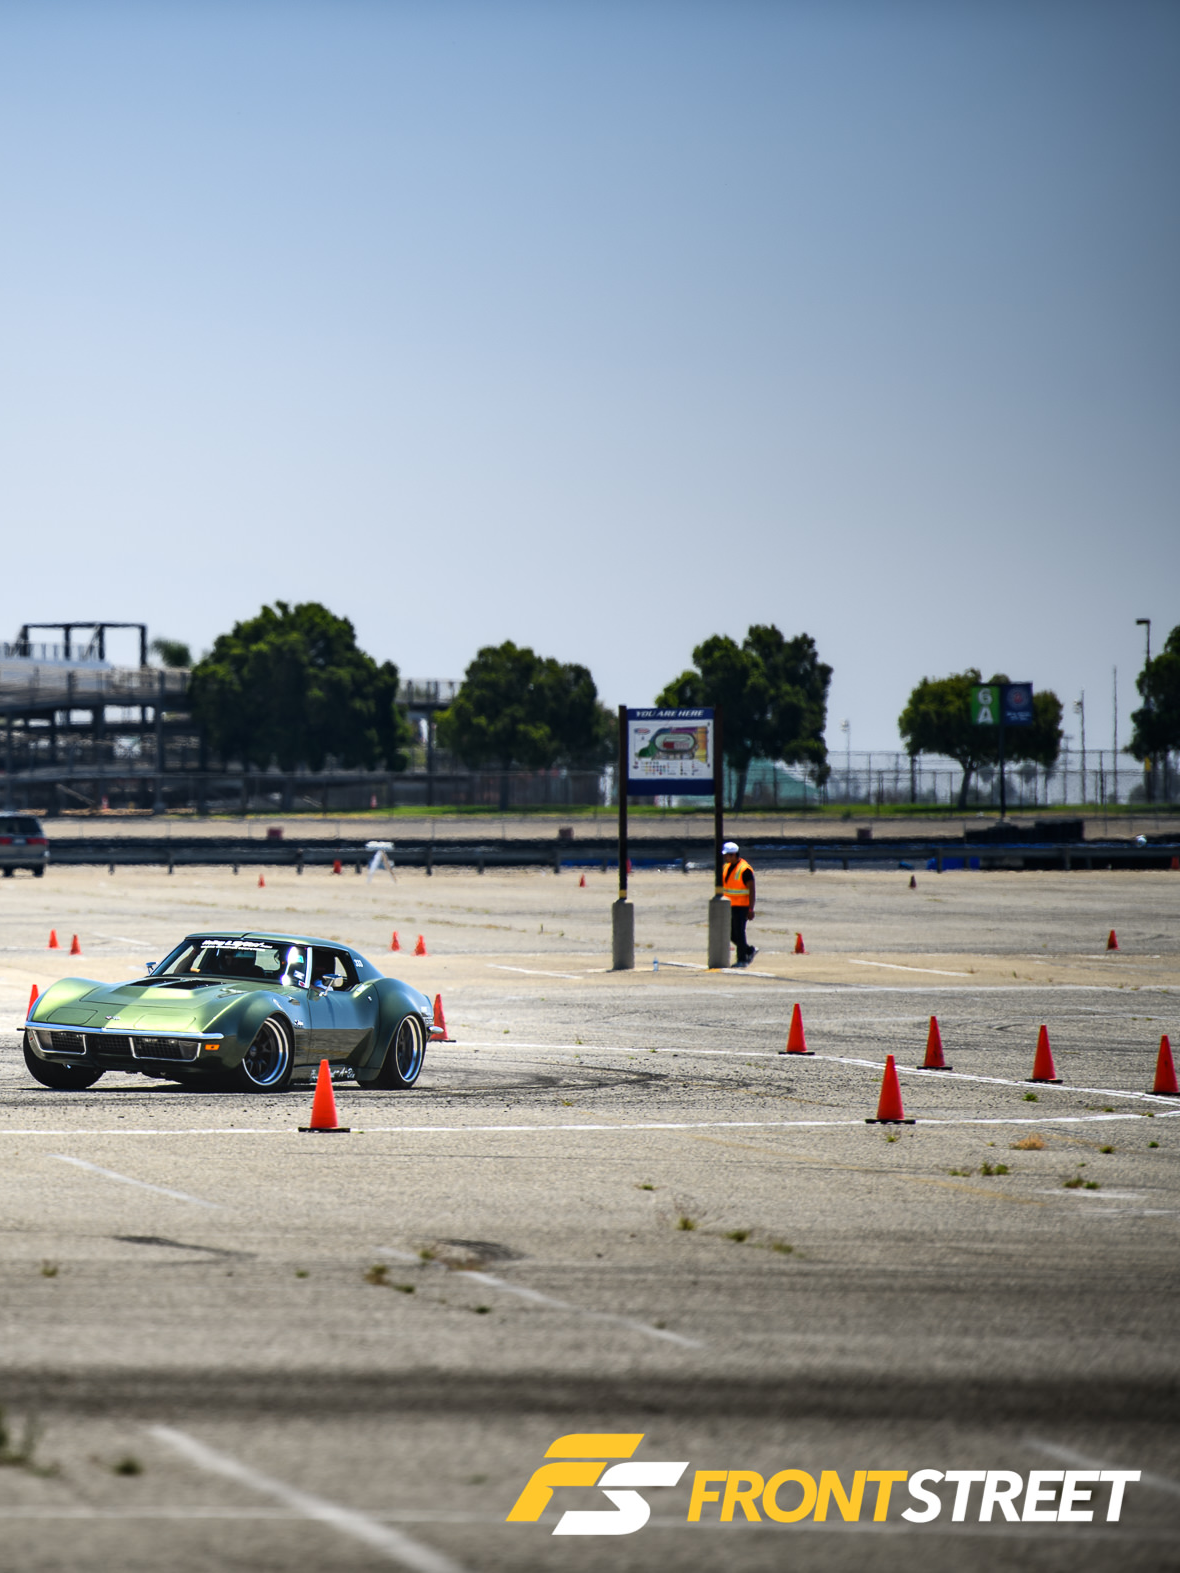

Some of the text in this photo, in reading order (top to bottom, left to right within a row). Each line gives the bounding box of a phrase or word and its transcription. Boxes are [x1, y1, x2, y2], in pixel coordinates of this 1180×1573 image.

[636, 709, 704, 718] YOU ARE HERE
[976, 706, 994, 725] A
